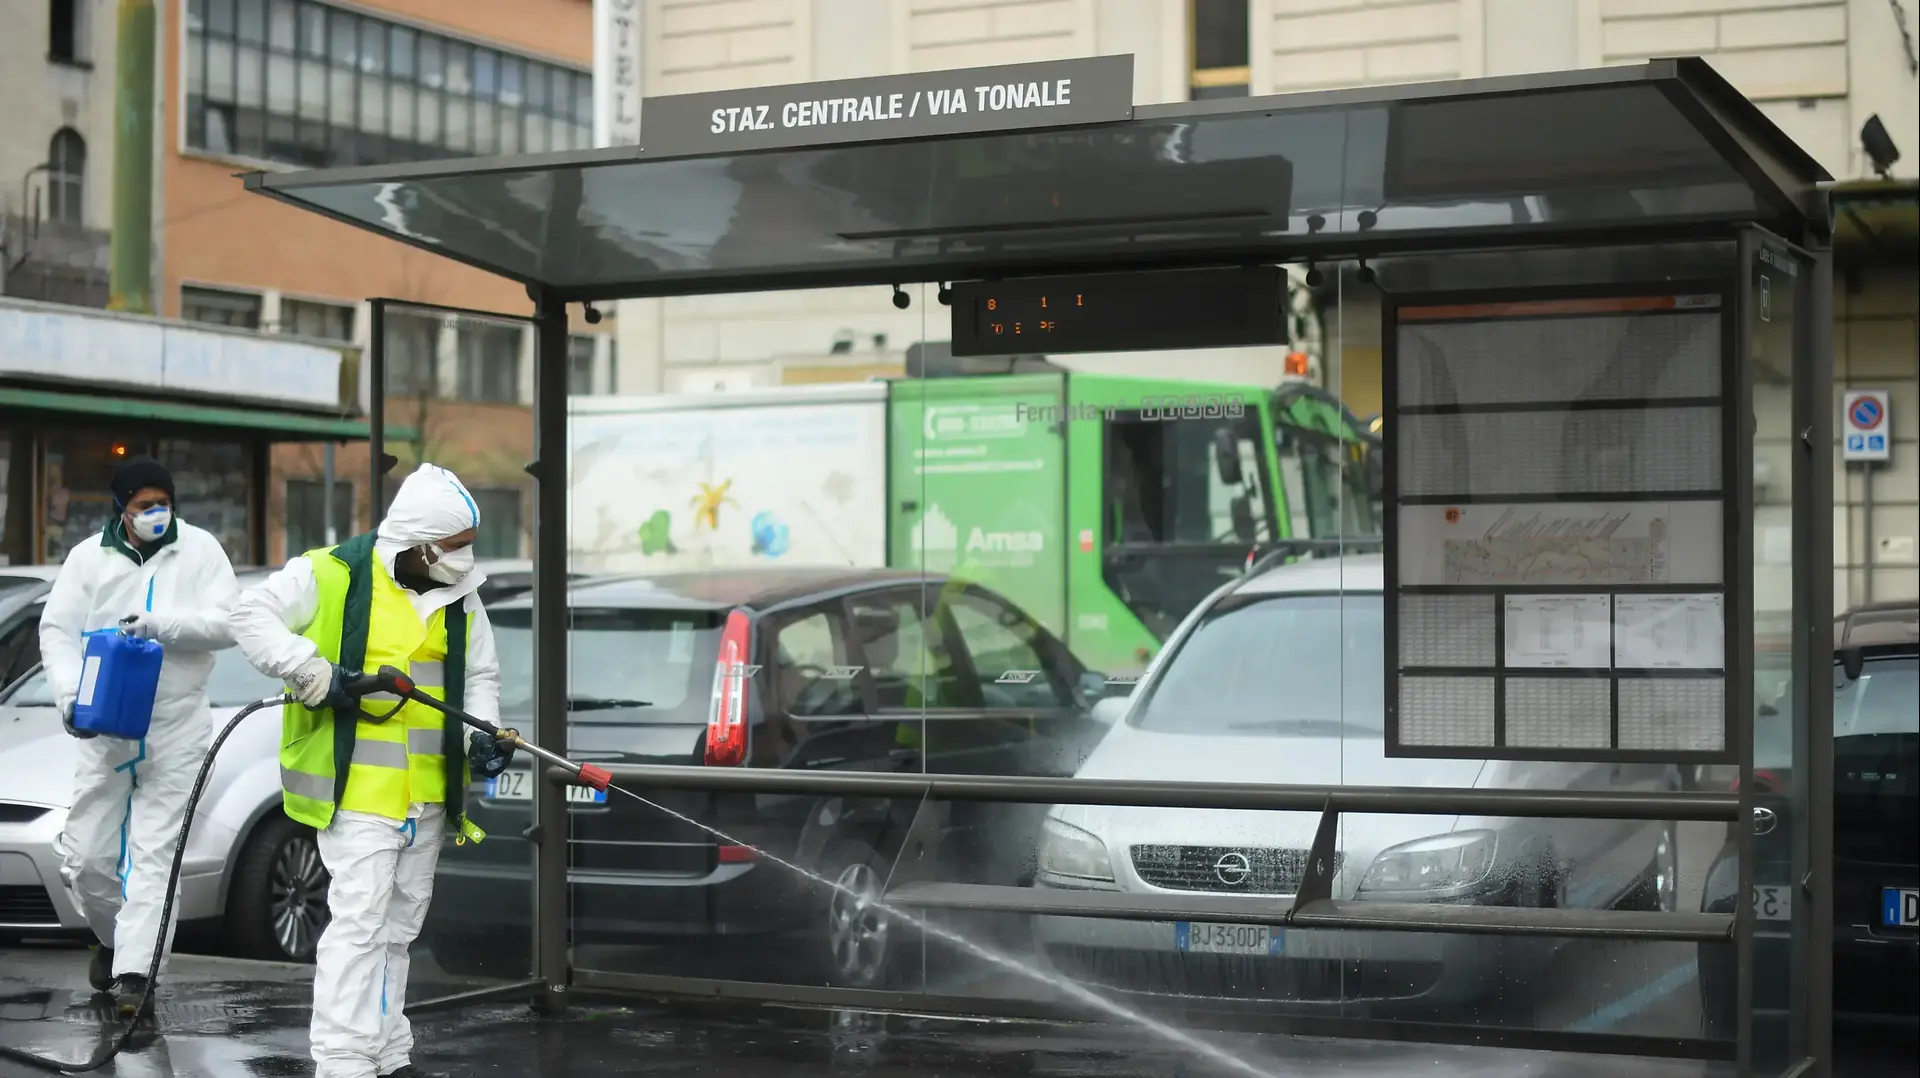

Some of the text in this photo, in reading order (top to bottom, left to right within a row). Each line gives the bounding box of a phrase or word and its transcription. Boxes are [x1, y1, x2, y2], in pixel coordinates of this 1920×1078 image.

[710, 79, 1071, 134] STAZ. CENTRALE / VIA TONALE
[1015, 400, 1098, 423] Fermata
[499, 772, 525, 797] DZ
[1191, 924, 1211, 945] BJ
